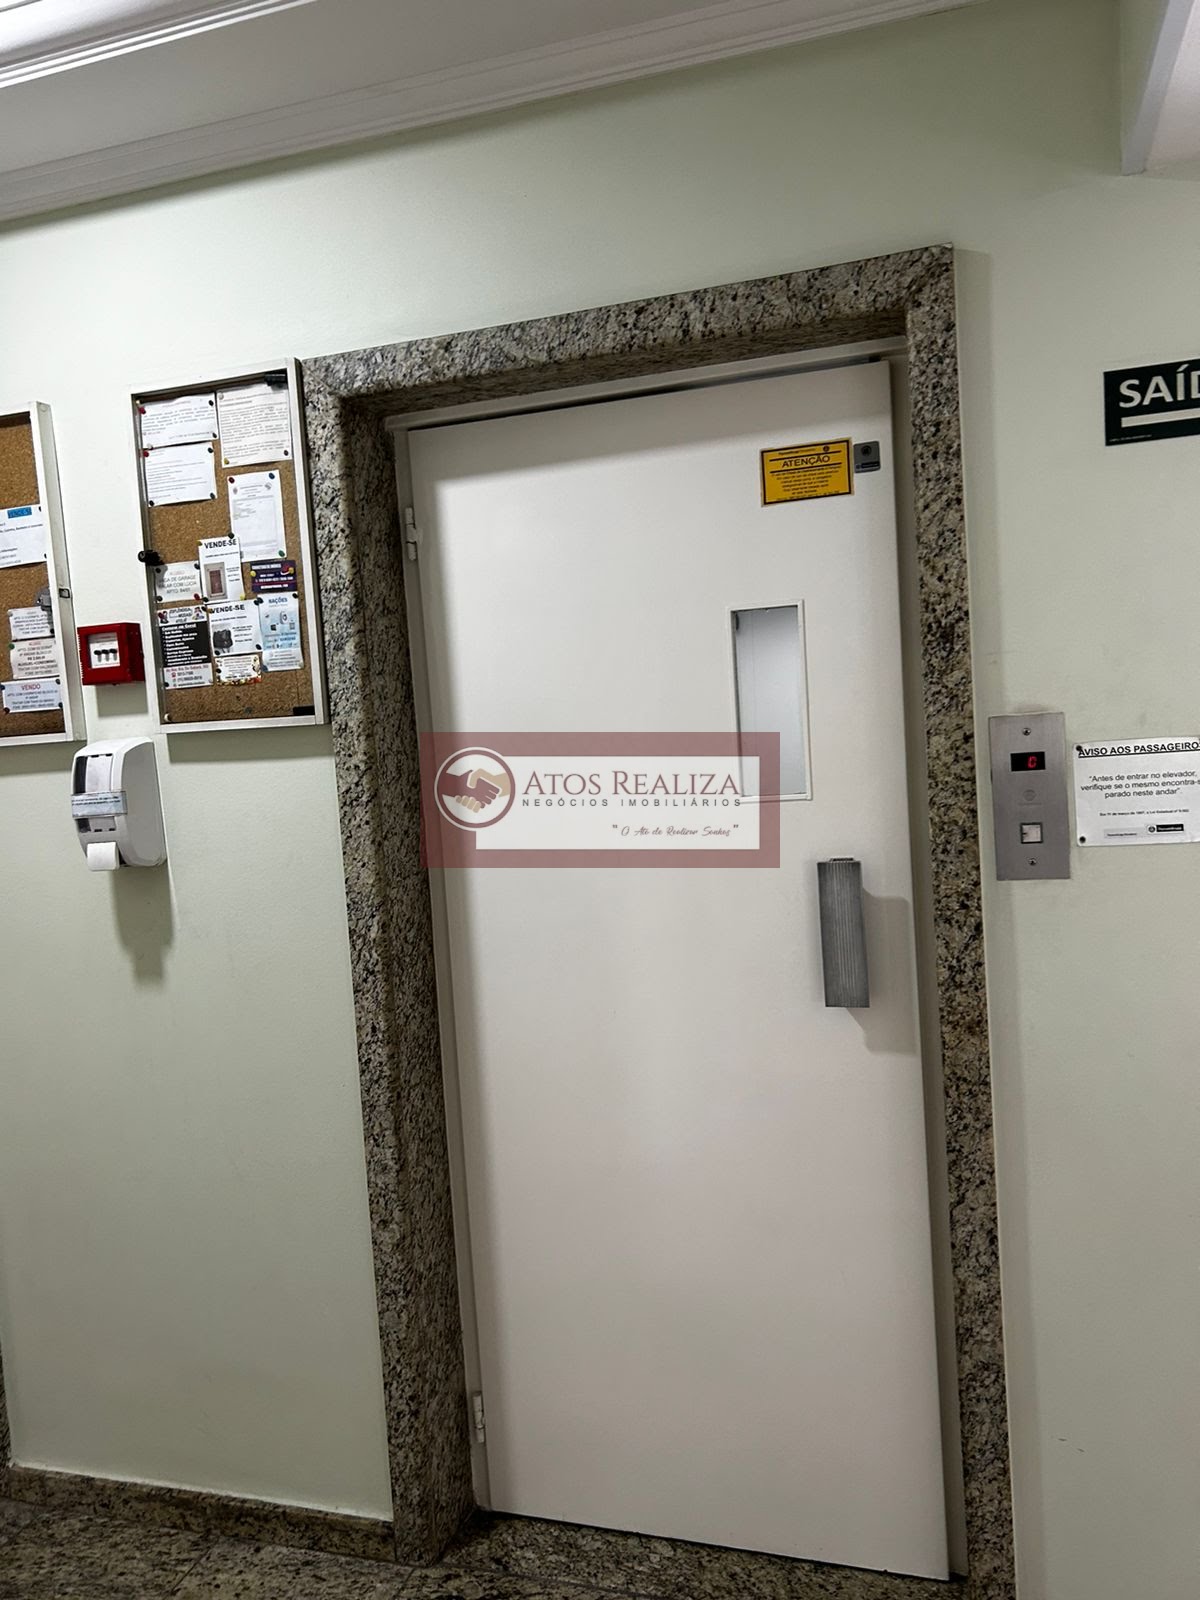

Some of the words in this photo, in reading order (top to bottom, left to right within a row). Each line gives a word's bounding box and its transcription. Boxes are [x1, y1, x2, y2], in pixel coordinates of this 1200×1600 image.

[782, 456, 830, 468] ATENÇÃO
[203, 539, 237, 549] VENDE-SE
[212, 604, 245, 614] VENDE-SE
[21, 683, 41, 691] VENDO
[1078, 747, 1108, 756] AVISO
[1110, 745, 1131, 754] AOS
[1133, 741, 1200, 753] PASSAGEIRO
[1115, 773, 1125, 781] de
[1162, 770, 1197, 778] elevador,
[1080, 783, 1112, 791] verifique
[1104, 789, 1131, 799] parado
[1132, 789, 1154, 797] neste
